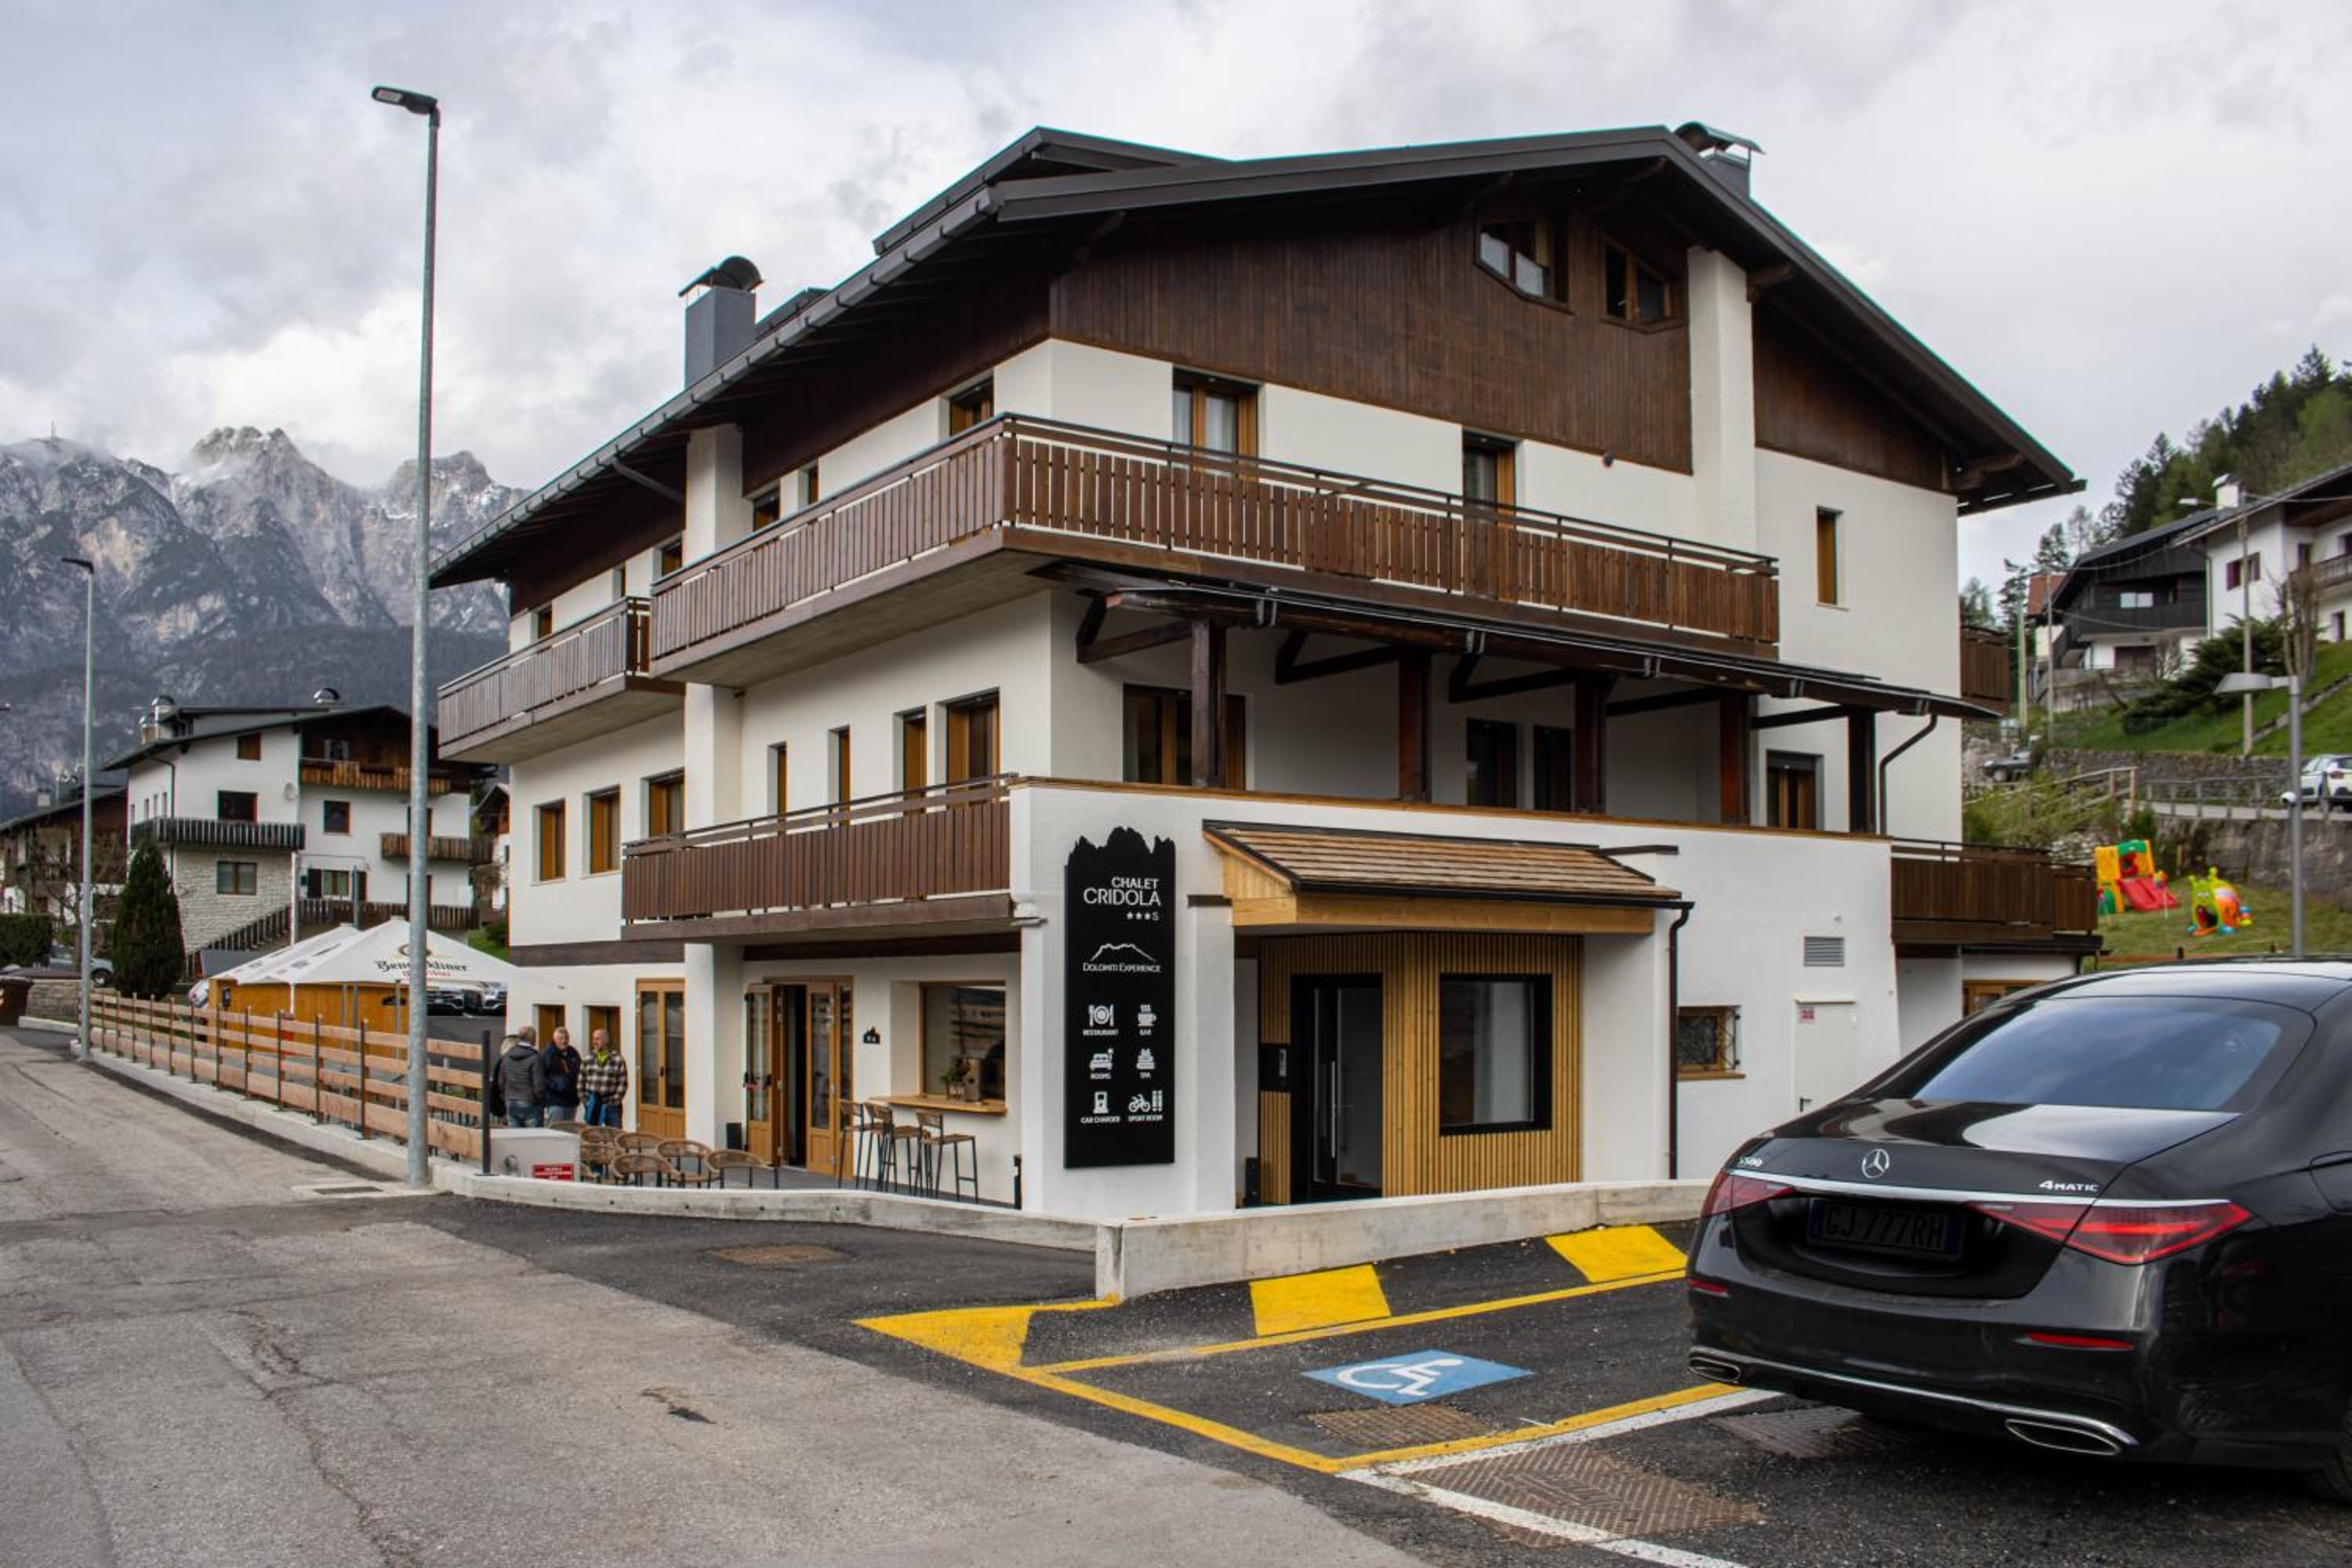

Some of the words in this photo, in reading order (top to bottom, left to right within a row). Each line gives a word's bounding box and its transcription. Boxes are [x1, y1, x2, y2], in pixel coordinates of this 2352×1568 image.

[1112, 877, 1160, 889] CHALET
[1083, 887, 1161, 906] CRIDOLA
[2038, 1180, 2100, 1192] 4MATIC
